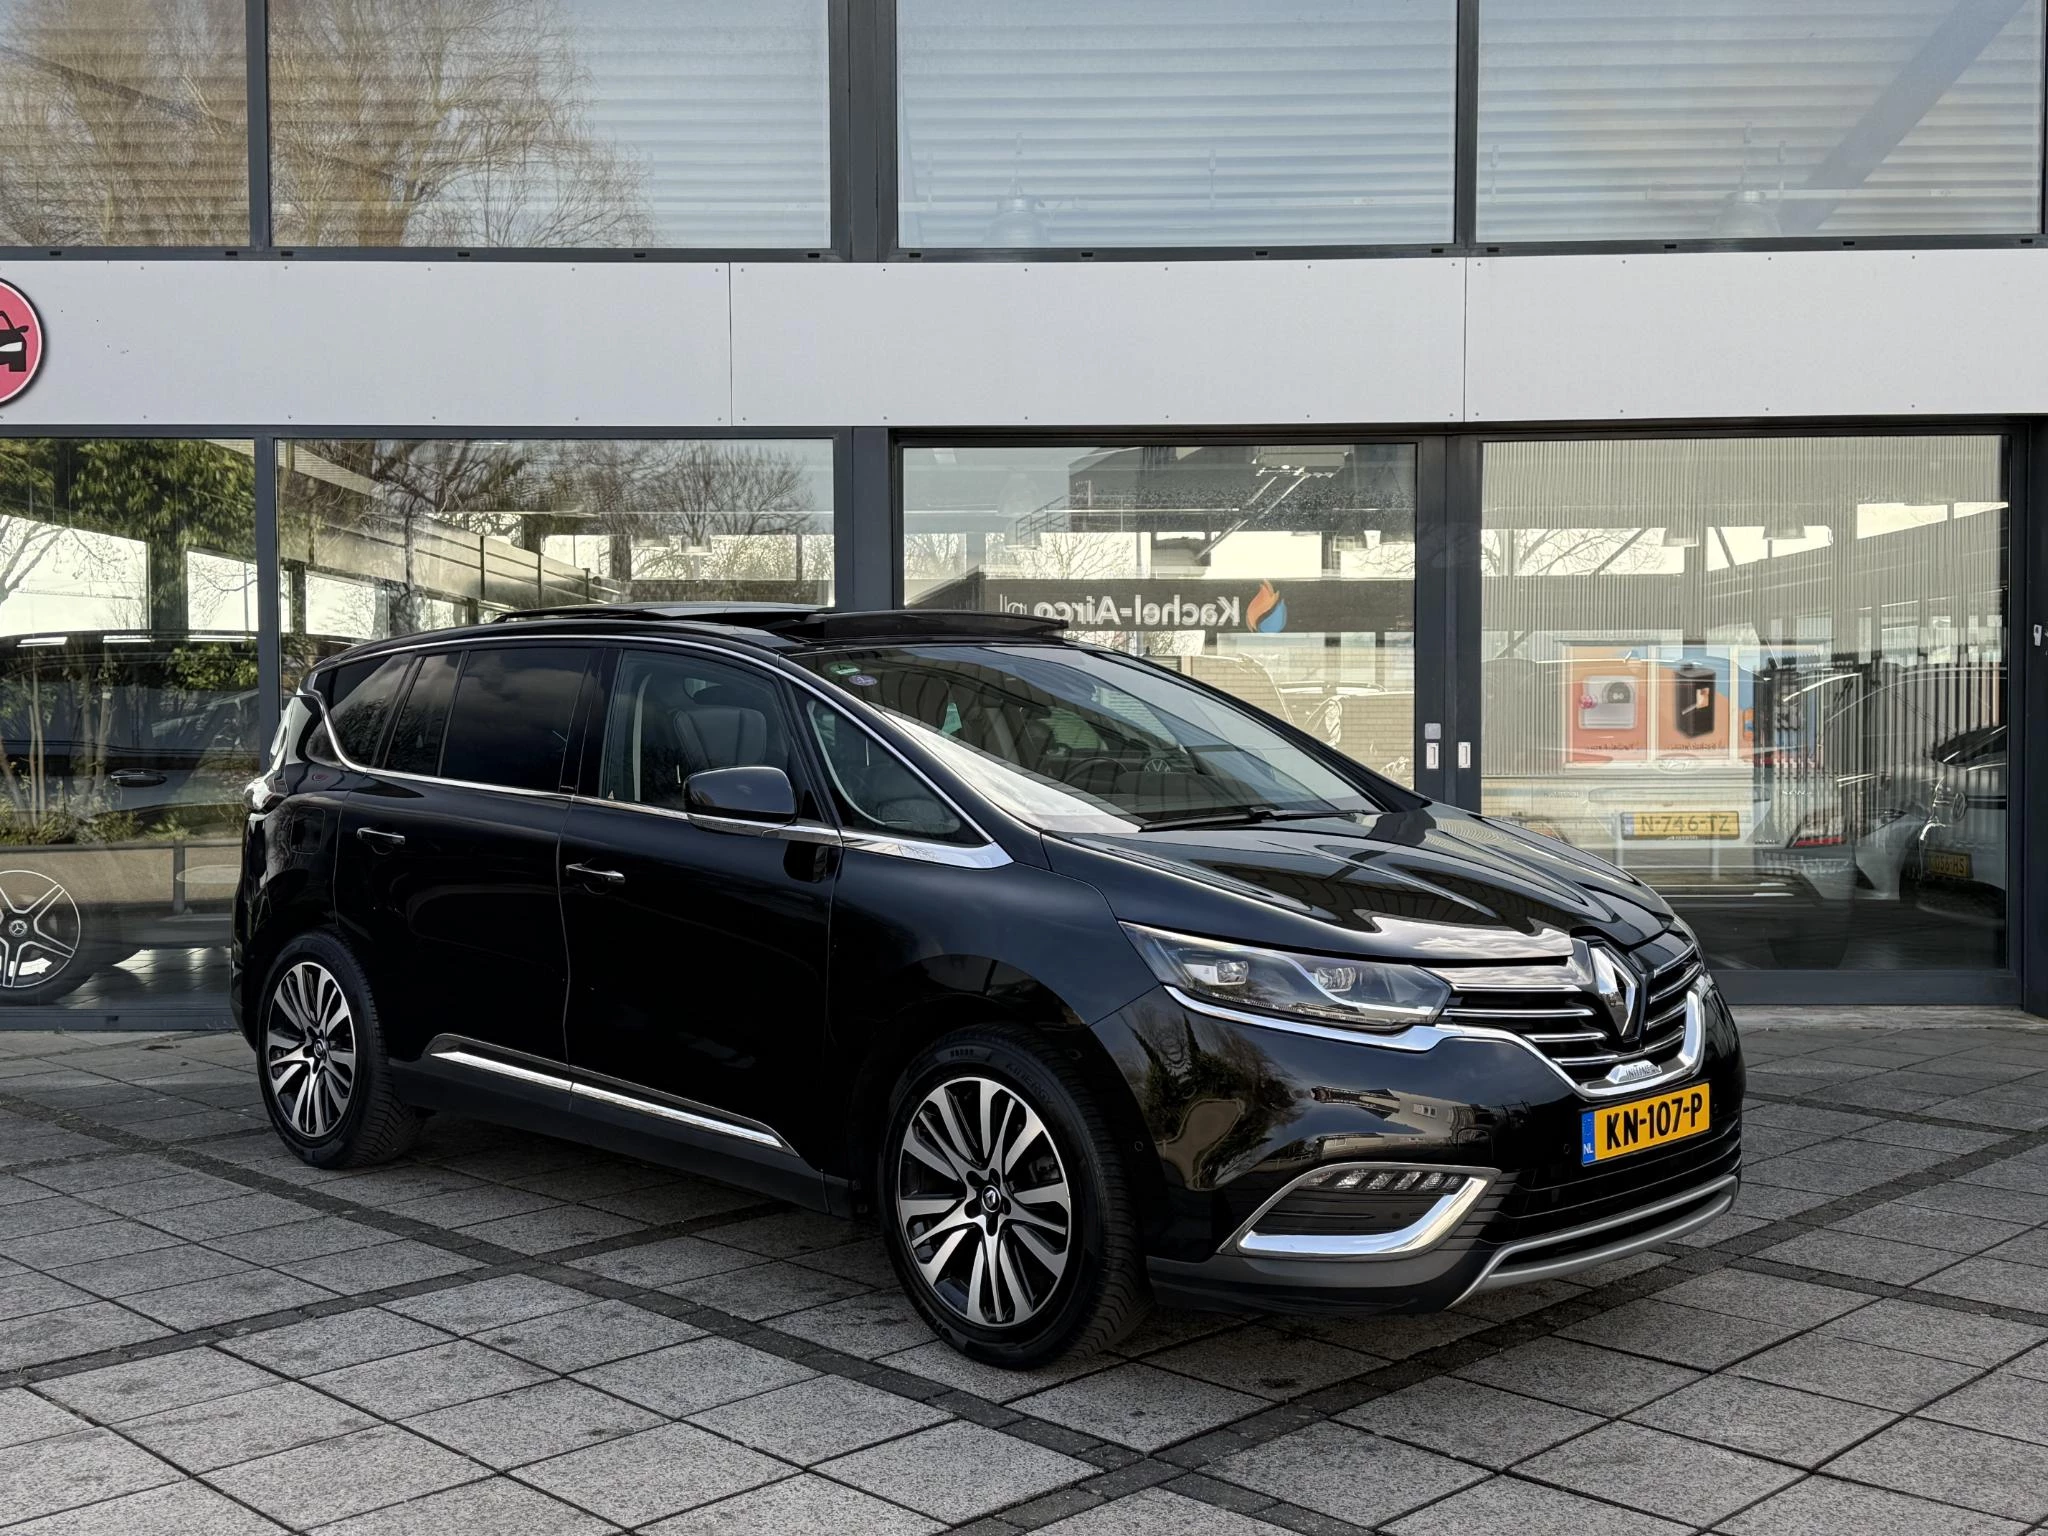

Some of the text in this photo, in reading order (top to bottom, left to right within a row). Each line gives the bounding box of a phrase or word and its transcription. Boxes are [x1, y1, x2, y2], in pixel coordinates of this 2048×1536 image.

[1640, 814, 1731, 833] N-746-TZ
[1606, 1092, 1703, 1150] KN-107-P
[1583, 1143, 1594, 1154] NL
